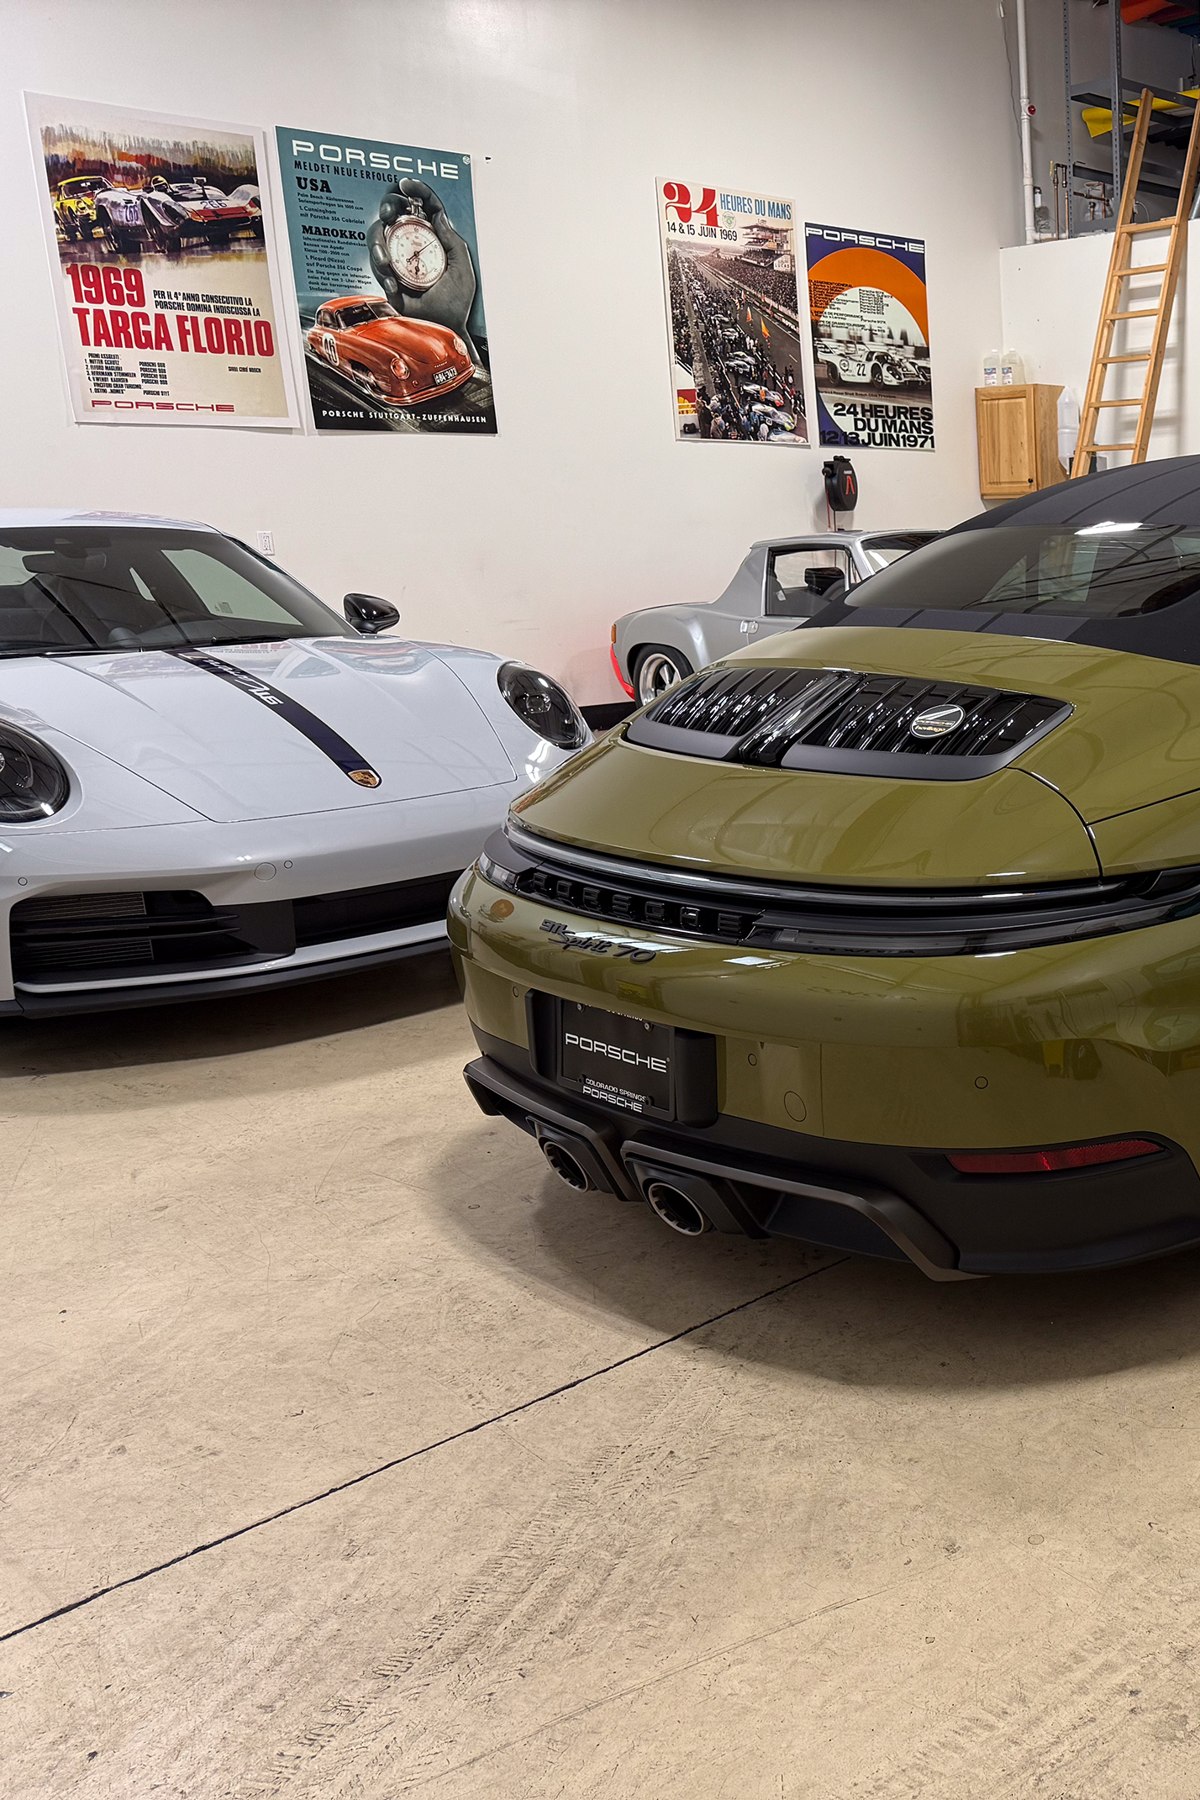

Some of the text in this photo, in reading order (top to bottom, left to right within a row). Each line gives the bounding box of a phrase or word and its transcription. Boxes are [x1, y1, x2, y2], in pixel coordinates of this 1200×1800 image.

[292, 139, 459, 180] PORSCHE
[294, 160, 398, 184] MELDET NEUE ERFOLGE
[296, 176, 333, 193] USA
[663, 182, 722, 228] 24
[720, 193, 753, 214] HEURES
[754, 199, 766, 217] DU
[767, 201, 793, 221] MANS
[302, 224, 366, 241] MAROKKO
[667, 224, 739, 242] 14 & 15 JUIN 1969
[806, 227, 925, 254] PORSCHE
[66, 264, 146, 308] 1969
[153, 290, 163, 300] PER
[166, 291, 173, 300] IL
[182, 293, 200, 304] ANNO
[201, 294, 244, 307] CONSECUTIVO
[245, 298, 253, 308] LA
[154, 300, 261, 318] PORSCHE DOMINA INDISCUSSA LA
[72, 307, 275, 358] TARGA FLORIO
[857, 363, 867, 377] 22
[91, 399, 235, 413] PORSCHE
[322, 410, 365, 420] PORSCHE
[833, 402, 934, 422] 24 HEURES
[853, 417, 934, 436] DU MANS
[861, 431, 901, 448] JUIN
[900, 432, 936, 450] 1971
[532, 871, 742, 933] PORSCHE
[548, 929, 657, 964] Spirit 70
[565, 1032, 668, 1074] PORSCHE
[582, 1085, 644, 1113] PORSCHE
[585, 1078, 648, 1103] COLORADO SPRINGS
